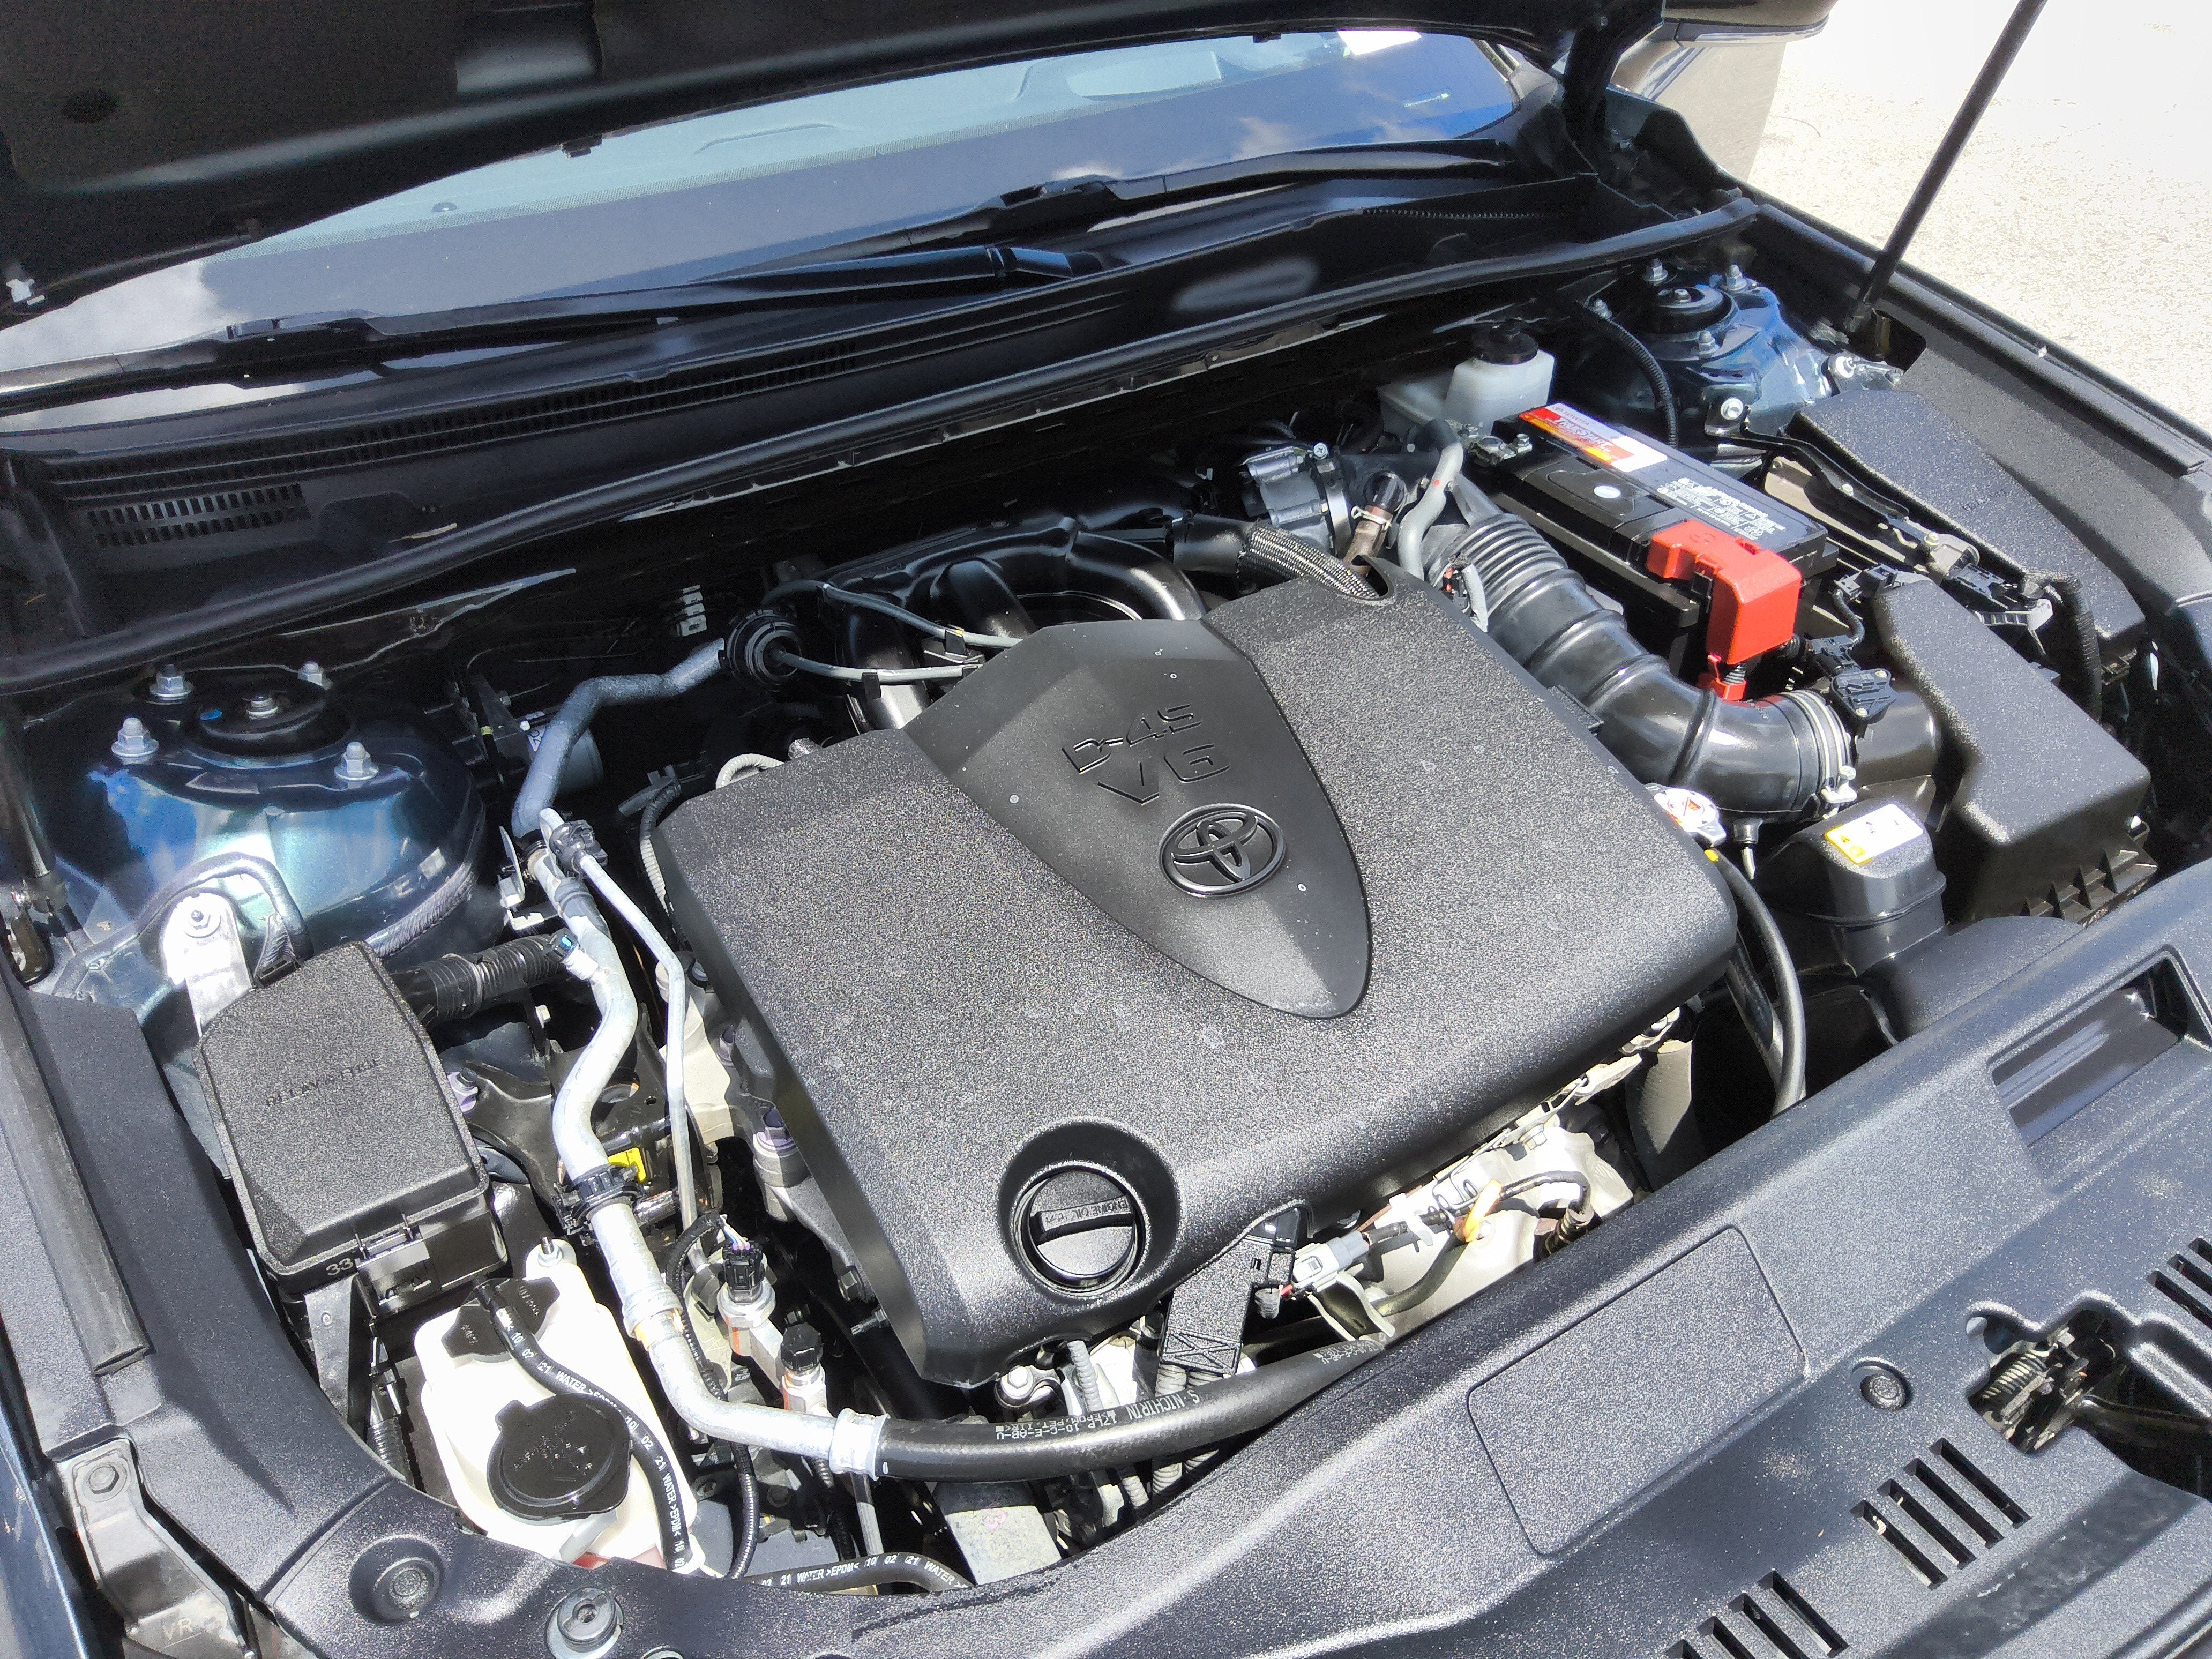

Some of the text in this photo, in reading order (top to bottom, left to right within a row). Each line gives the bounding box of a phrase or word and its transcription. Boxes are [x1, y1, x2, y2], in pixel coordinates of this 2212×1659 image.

[1097, 744, 1231, 805] V6
[326, 1258, 354, 1276] 33
[555, 1370, 587, 1393] WATER
[641, 1435, 653, 1451] 02
[662, 1472, 677, 1504] WATER
[797, 1568, 824, 1583] WATER
[924, 1560, 955, 1585] WATER
